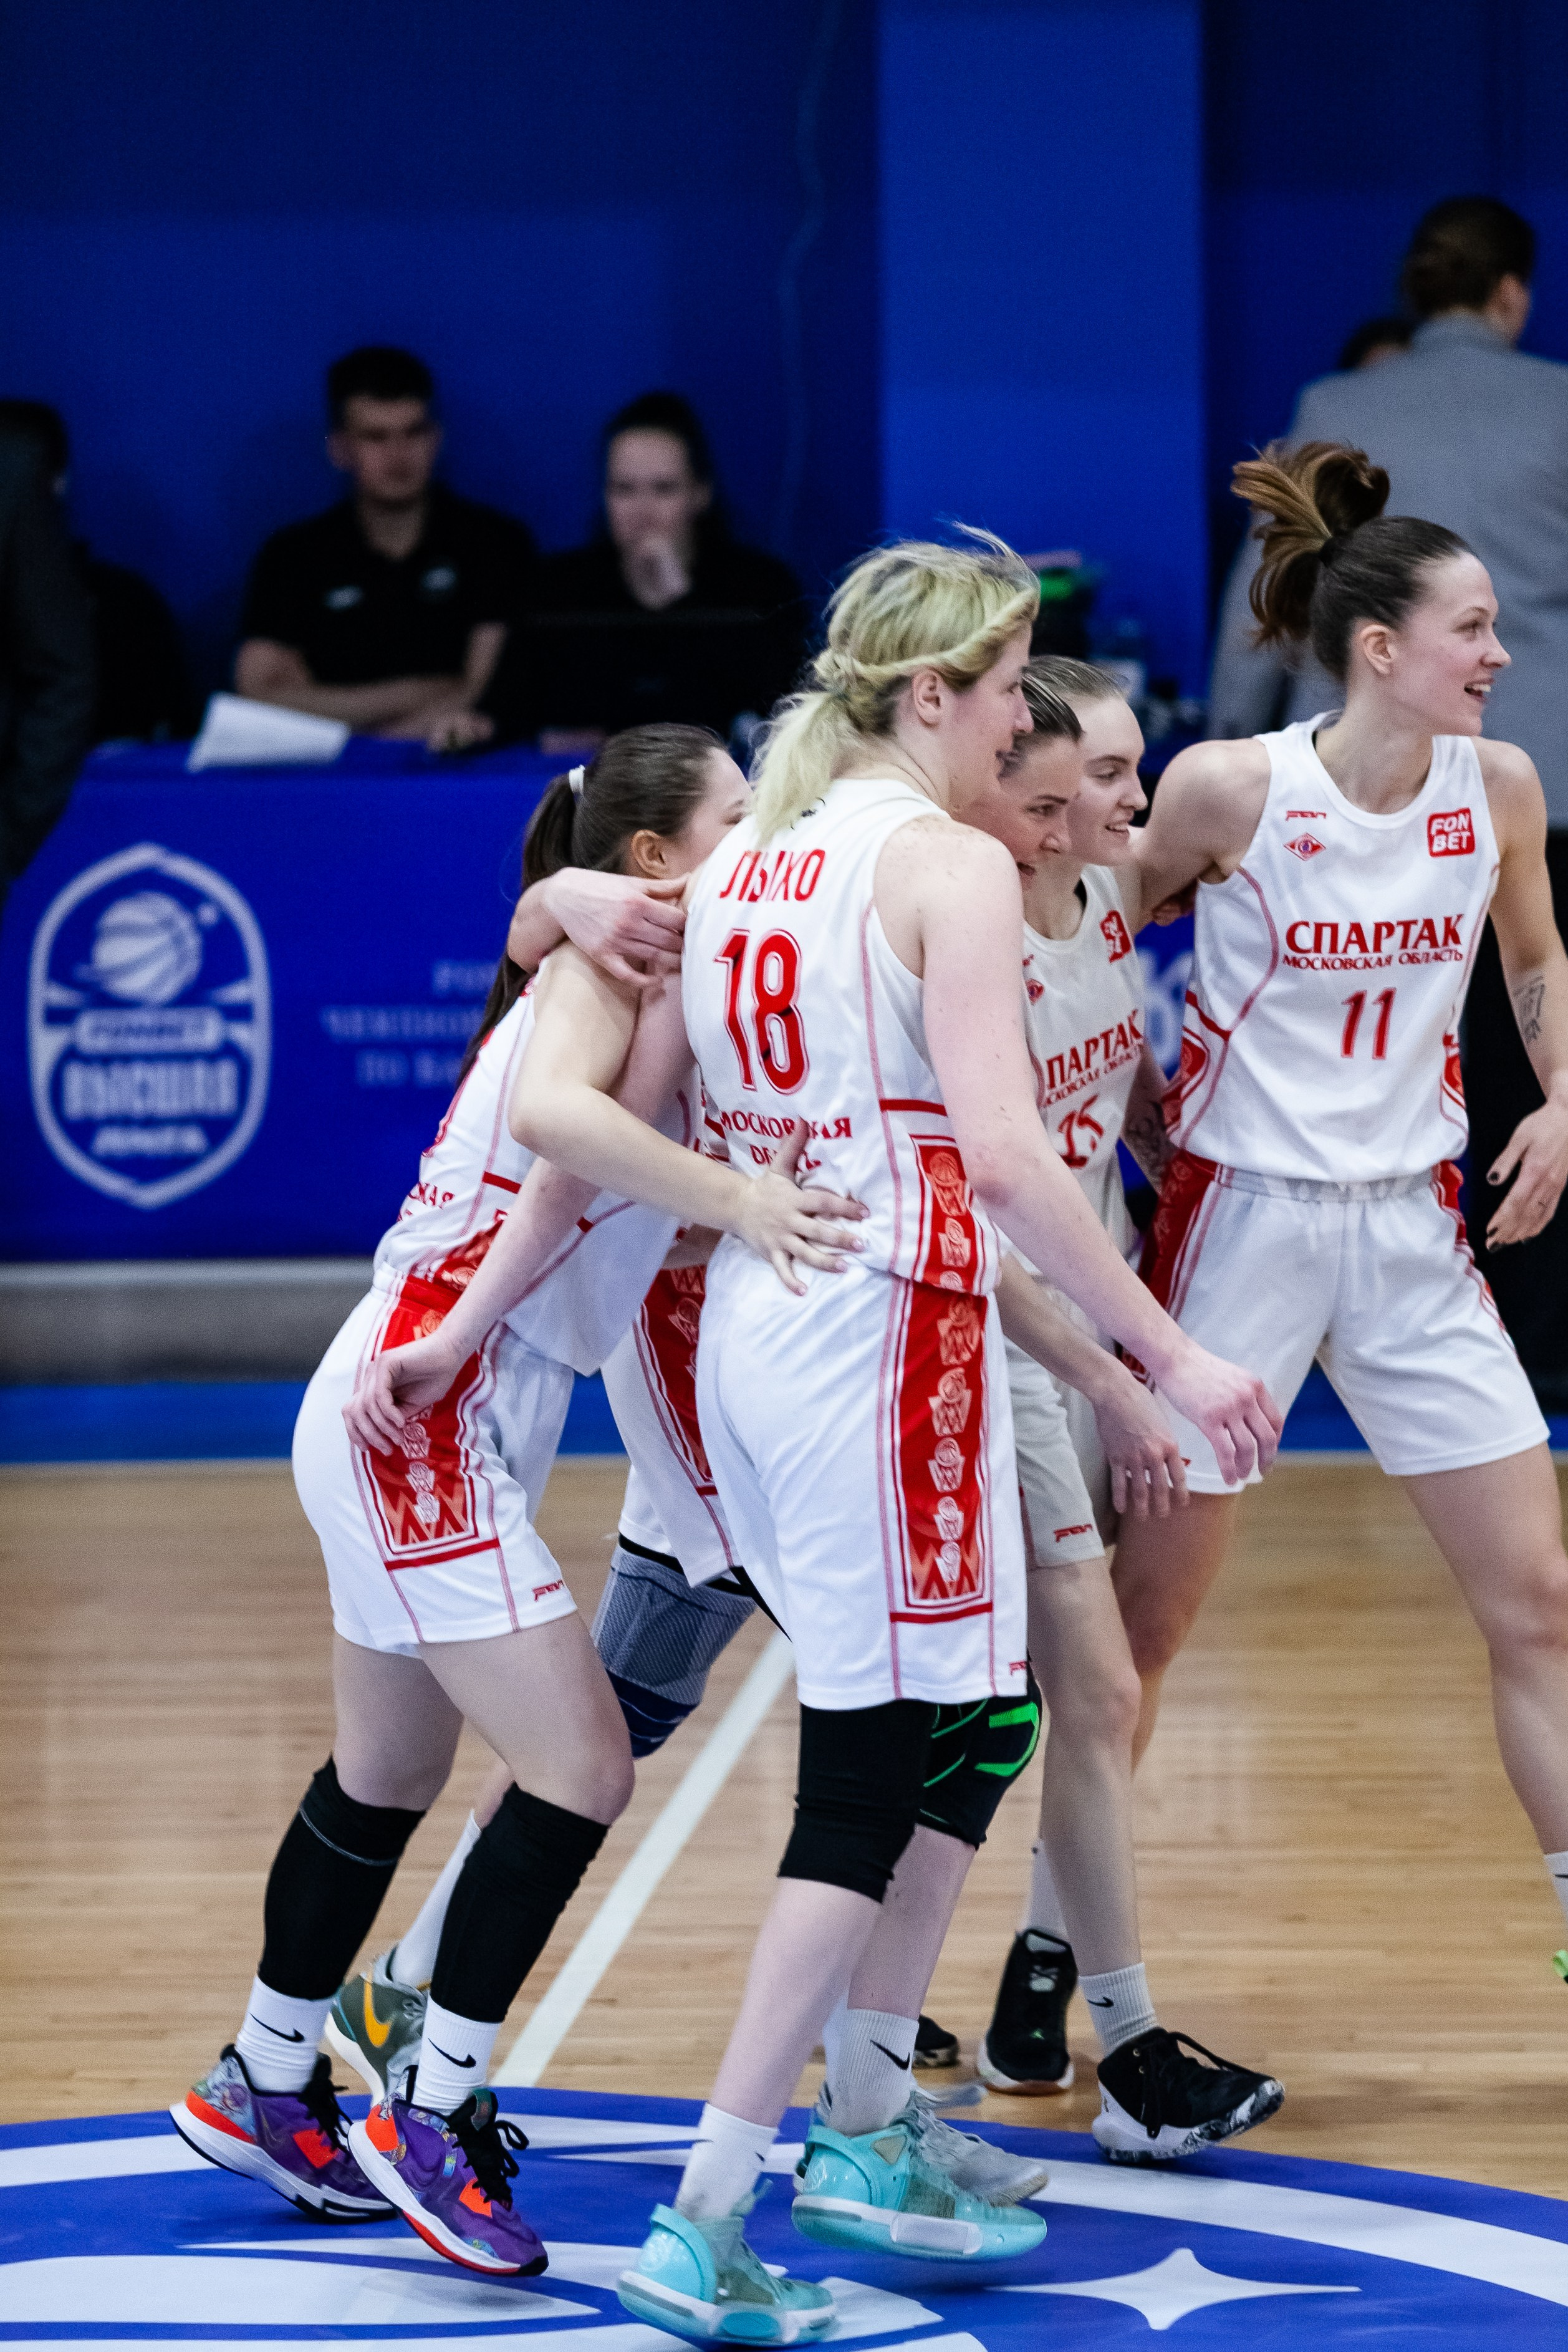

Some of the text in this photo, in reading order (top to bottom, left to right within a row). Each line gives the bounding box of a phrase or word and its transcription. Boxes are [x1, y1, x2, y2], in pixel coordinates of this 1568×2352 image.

[1431, 812, 1470, 836] FON
[1432, 831, 1471, 852] BET
[719, 849, 825, 902] ЛЫХО
[1285, 913, 1465, 955] СПАРТАК
[1282, 948, 1464, 971] МОСКОВСКАЯ ОБЛАСТЬ
[714, 928, 810, 1095] 18
[1341, 987, 1397, 1060] 11
[1045, 1008, 1143, 1090] ПАРТАК
